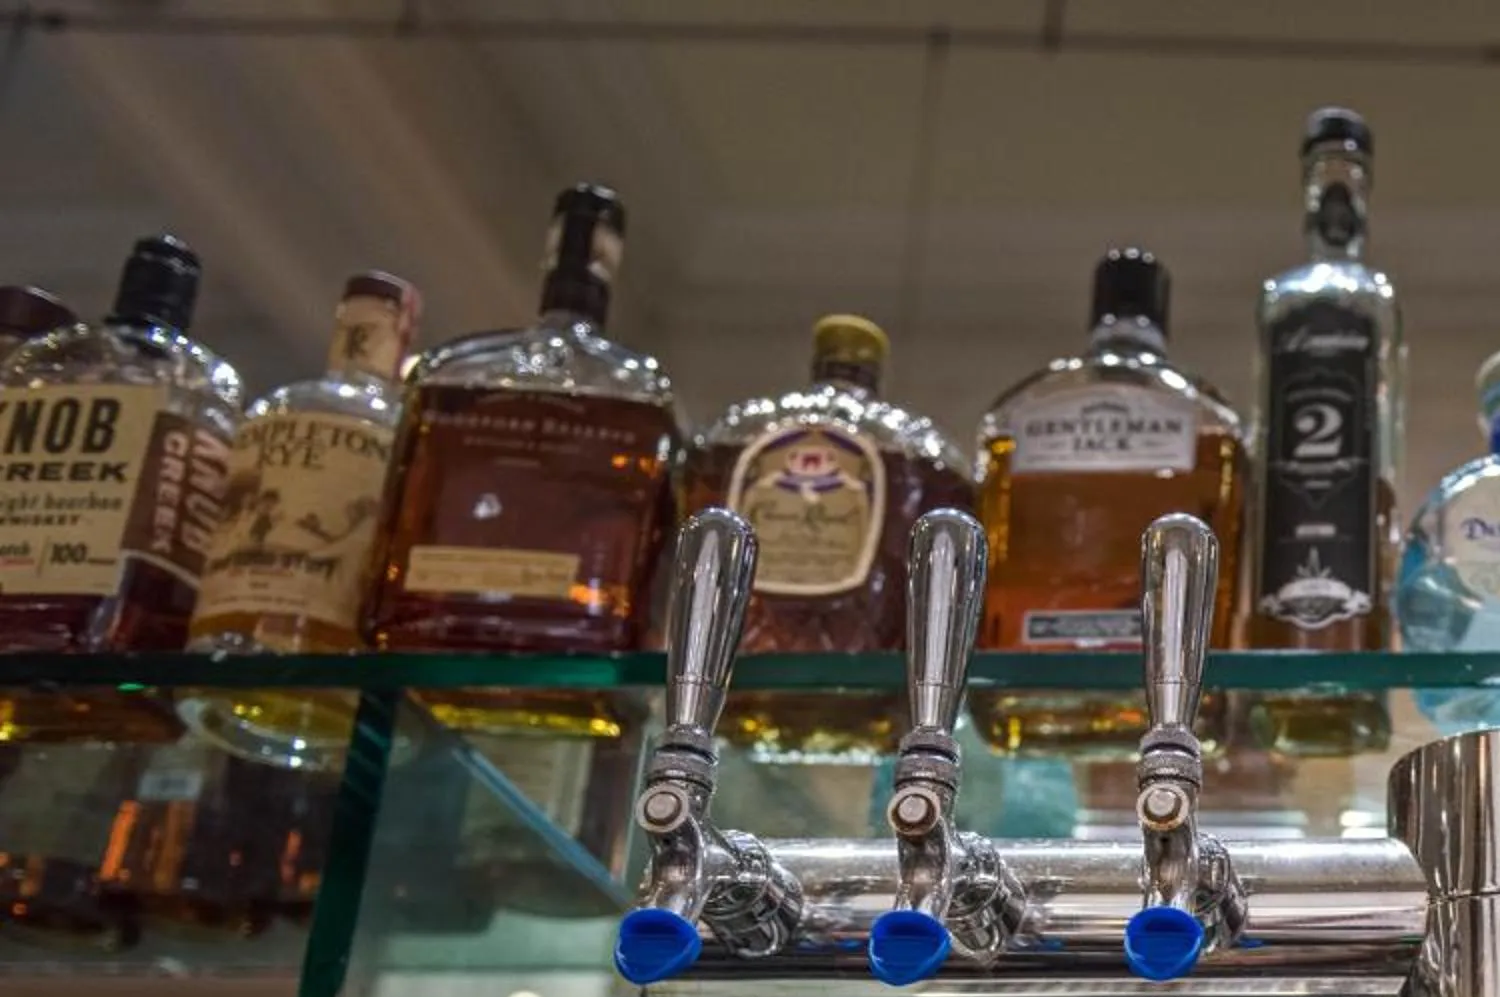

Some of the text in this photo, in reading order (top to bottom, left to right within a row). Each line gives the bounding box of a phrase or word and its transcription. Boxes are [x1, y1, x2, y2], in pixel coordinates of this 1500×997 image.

[0, 397, 121, 453] NOB
[1293, 403, 1342, 456] 2
[0, 461, 129, 482] REEK
[50, 543, 88, 563] 100
